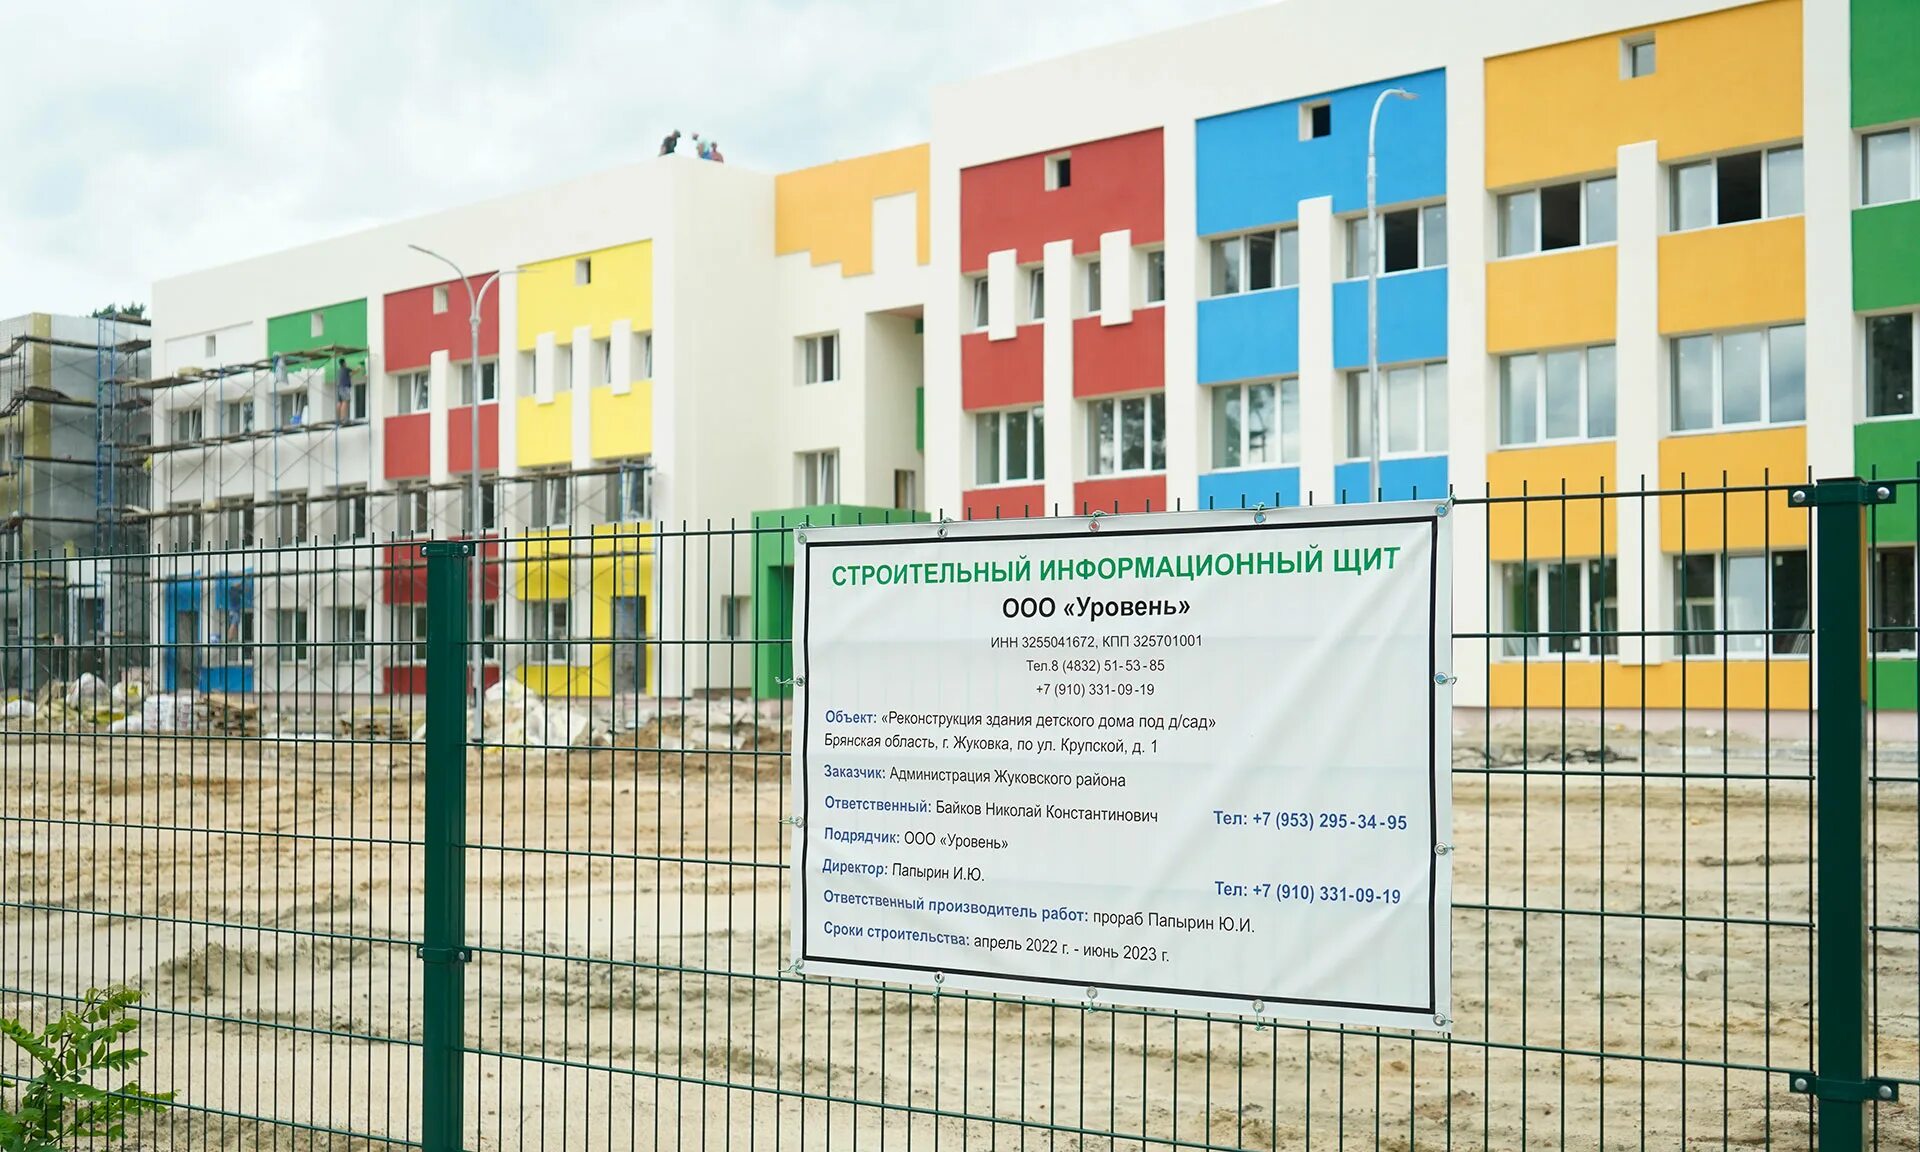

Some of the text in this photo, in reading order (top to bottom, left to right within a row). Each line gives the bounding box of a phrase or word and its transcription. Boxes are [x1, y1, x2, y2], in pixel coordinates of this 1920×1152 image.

[831, 544, 1400, 586] СТРОИТЕЛЬНЫЙ ИНФОРМАЦИОННЫЙ ЩИТ
[1002, 597, 1190, 622] ООО «Уровень»
[990, 635, 1201, 649] ИНН 3255041672, КПП 325701001
[1062, 660, 1100, 674] (4832)
[1037, 684, 1154, 698] +7 (910) 331-09-19
[825, 710, 1215, 731] Объект: «Реконструкция здания детского дома под д/сад»
[824, 733, 1157, 755] Брянская область, г. Жуковка, по ул. Крупской, д. 1
[823, 764, 1125, 789] Заказчик: Администрация Жуковского района
[824, 796, 1157, 822] Ответственный: Байков Николай Константинович
[1212, 811, 1407, 831] Тел: +7 (953) 295-34-95
[824, 827, 1008, 850] Подрядчик: ООО «Уровень»
[821, 859, 984, 881] Директор: Папырин И.Ю.
[1214, 881, 1400, 904] Тел: +7 (910) 331-09-19
[823, 890, 1254, 932] Ответственный производитель работ: прораб Папырин Ю.И.
[823, 921, 863, 937] Сроки
[866, 928, 969, 946] строительства:
[973, 937, 1022, 951] апрель
[1025, 938, 1057, 953] 2022
[1062, 943, 1069, 954] г.
[1083, 946, 1119, 958] июнь
[1122, 945, 1156, 961] 2023
[1162, 951, 1169, 961] г.
